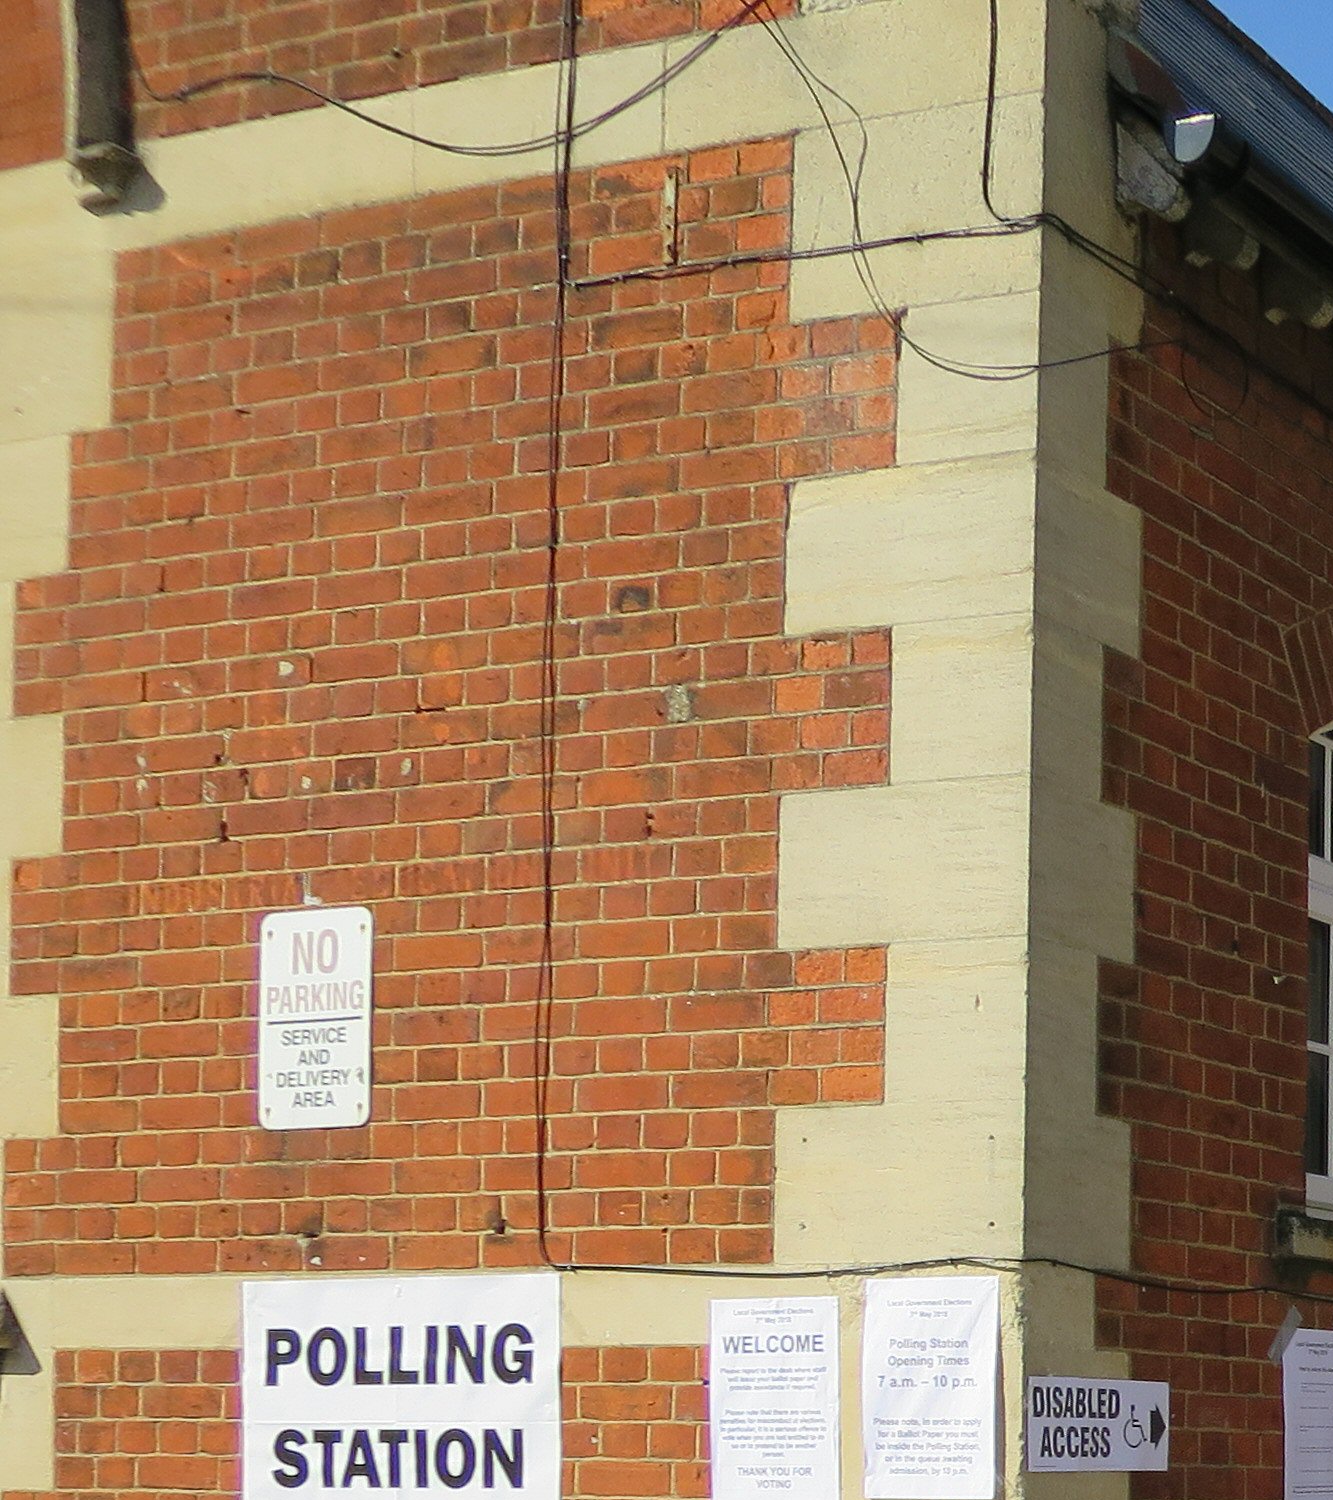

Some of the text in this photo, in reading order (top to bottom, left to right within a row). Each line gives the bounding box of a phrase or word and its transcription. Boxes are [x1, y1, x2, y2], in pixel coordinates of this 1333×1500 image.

[292, 928, 339, 975] NO
[266, 979, 364, 1015] PARKING
[280, 1027, 347, 1046] SERVICE
[297, 1049, 331, 1066] AND
[275, 1069, 350, 1088] DELIVERY
[292, 1091, 336, 1108] AREA
[722, 1334, 824, 1354] WELCOME
[889, 1337, 969, 1351] Polling Station
[265, 1323, 534, 1386] POLLING
[888, 1355, 969, 1368] Opening Times
[878, 1375, 886, 1388] 7
[890, 1378, 917, 1388] a.m.
[933, 1375, 947, 1388] 10
[1032, 1386, 1120, 1419] DISABLED
[1040, 1426, 1111, 1458] ACCESS
[271, 1428, 524, 1489] STATION
[737, 1466, 812, 1477] THANK YOU FOR
[756, 1479, 791, 1489] VOTING
